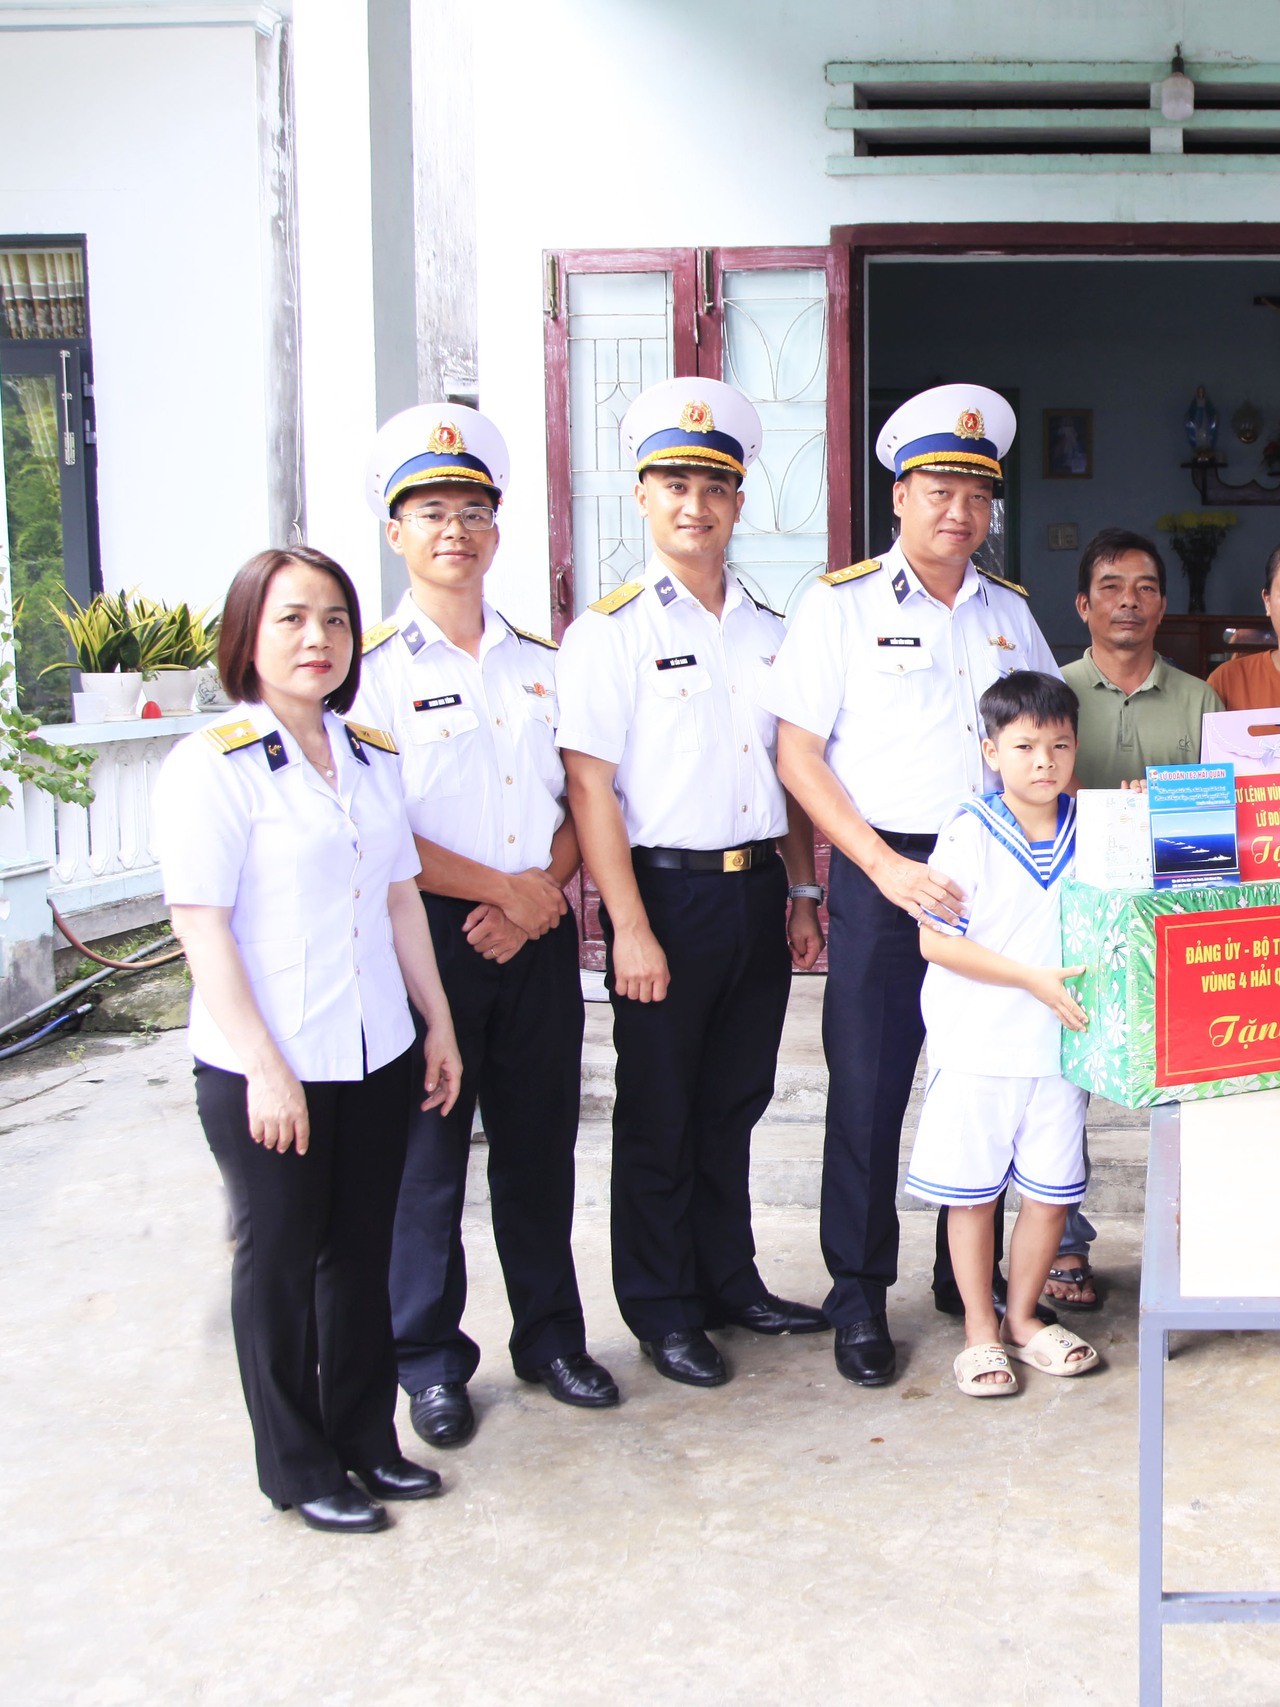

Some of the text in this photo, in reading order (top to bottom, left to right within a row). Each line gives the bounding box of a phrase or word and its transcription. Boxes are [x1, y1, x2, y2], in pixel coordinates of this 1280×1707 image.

[1245, 785, 1266, 806] LỆNH
[1256, 810, 1267, 827] LỮ
[1185, 940, 1221, 965] ĐẢNG
[1224, 937, 1241, 961] ỦY
[1252, 935, 1270, 960] BỘ
[1201, 972, 1236, 994] VÙNG
[1239, 972, 1248, 989] 4
[1250, 964, 1271, 988] HẢI
